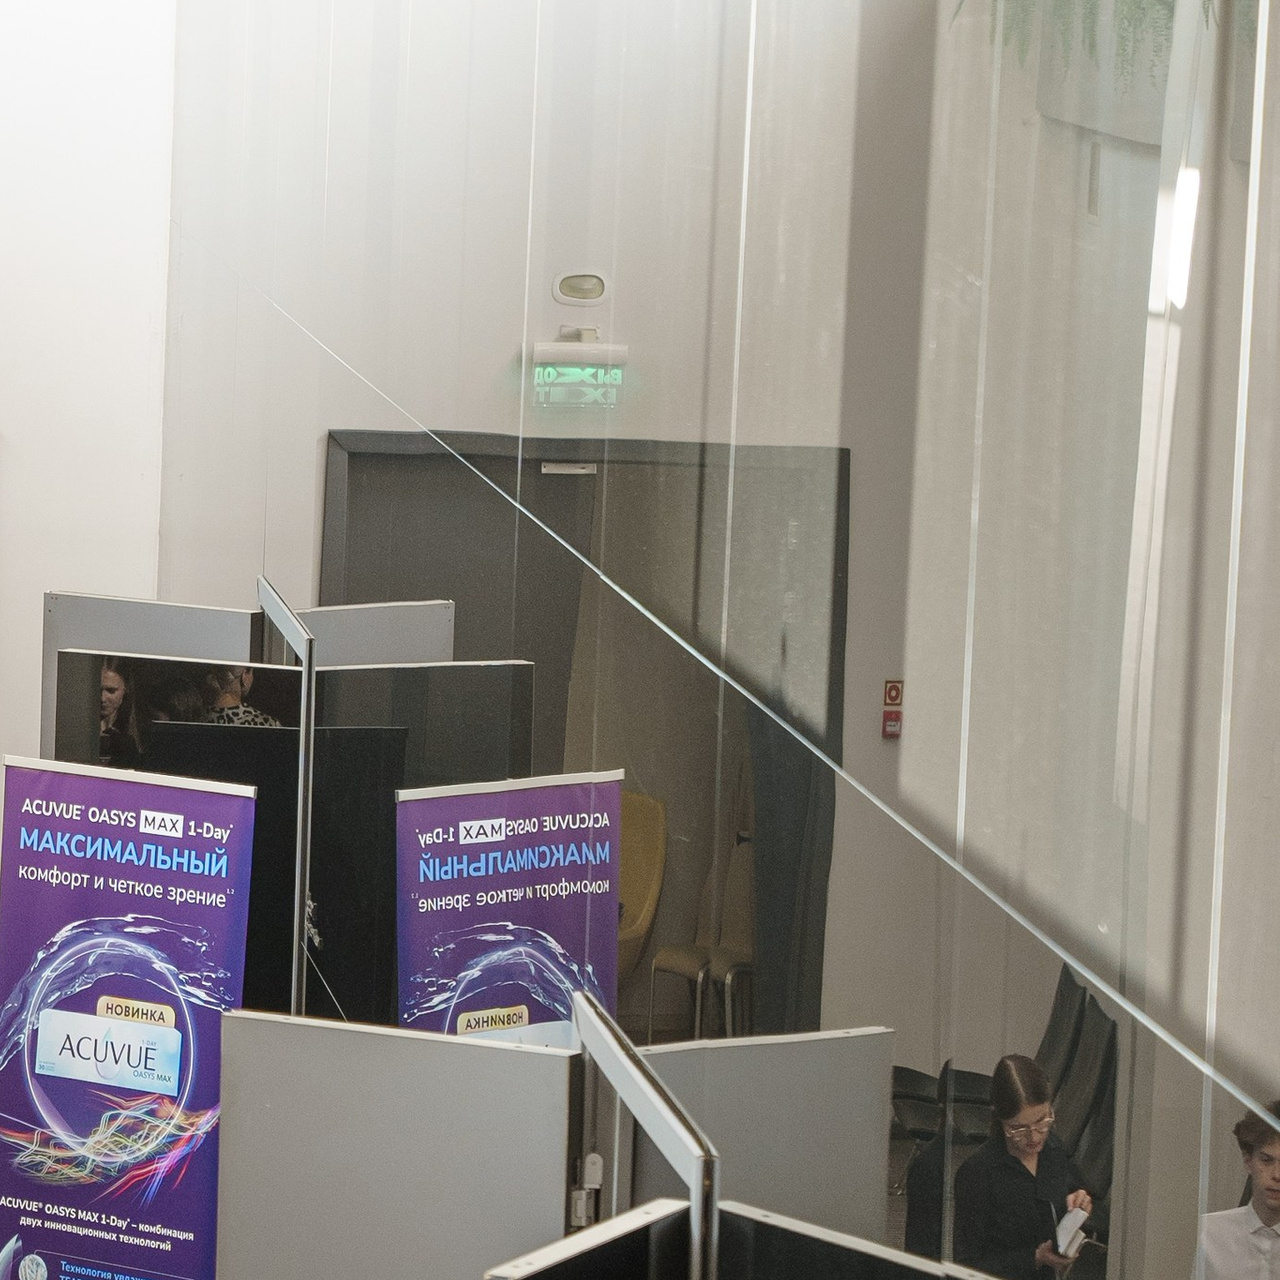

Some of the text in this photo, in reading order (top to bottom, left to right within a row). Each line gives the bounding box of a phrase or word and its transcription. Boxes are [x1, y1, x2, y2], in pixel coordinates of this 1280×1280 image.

[88, 807, 137, 828] OASYS
[144, 815, 179, 833] MAX
[20, 826, 228, 878] МАКСИМАЛЬНЫЙ
[19, 865, 90, 890] комфорт
[94, 876, 104, 890] и
[108, 877, 163, 899] четкое
[105, 1002, 166, 1024] НОВИНКА
[58, 1033, 158, 1072] ACUVUE
[132, 1070, 172, 1083] OASYS MAX
[19, 1216, 172, 1252] двух инновационных технологий
[44, 1203, 77, 1219] OASYS
[77, 1209, 100, 1224] MAX
[138, 1223, 195, 1241] комбинация
[60, 1260, 112, 1280] Технология
